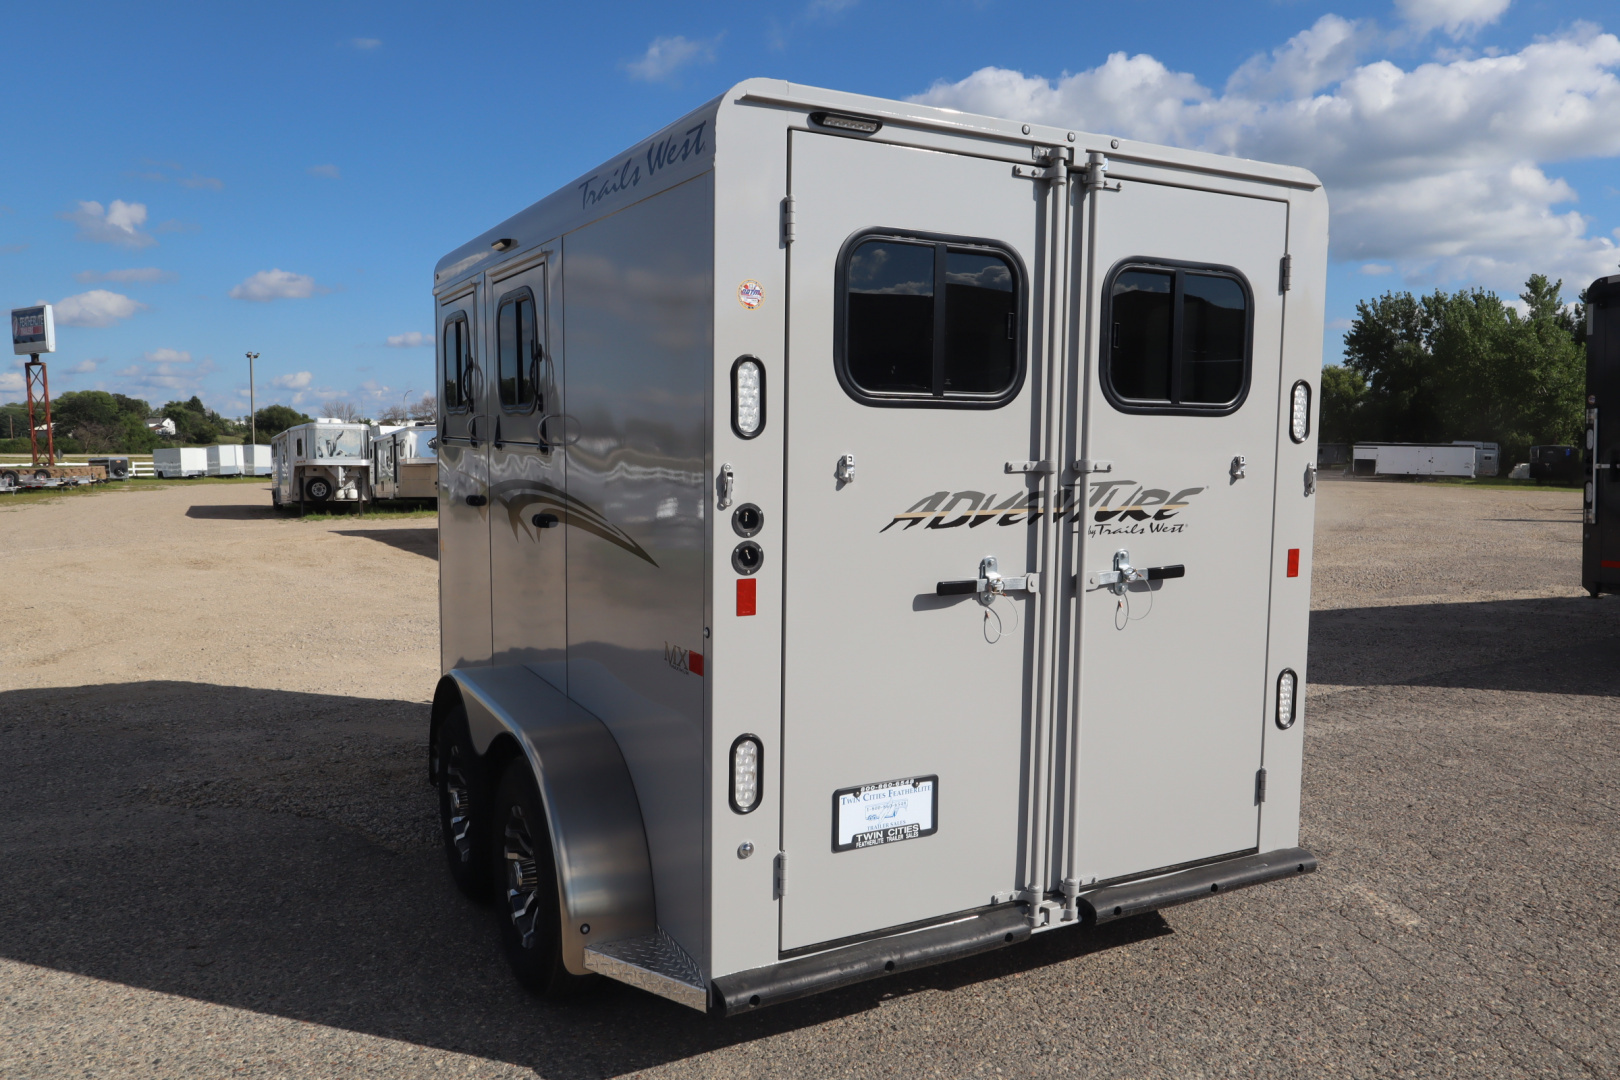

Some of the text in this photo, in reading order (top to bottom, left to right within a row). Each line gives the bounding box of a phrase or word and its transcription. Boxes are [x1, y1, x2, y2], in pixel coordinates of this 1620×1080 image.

[578, 120, 706, 210] Trails West
[1088, 522, 1185, 538] by Trails West
[664, 641, 688, 671] MX
[856, 824, 919, 840] TWIN CITIES
[856, 831, 919, 849] FEATHERLITE TRAILER SALES
